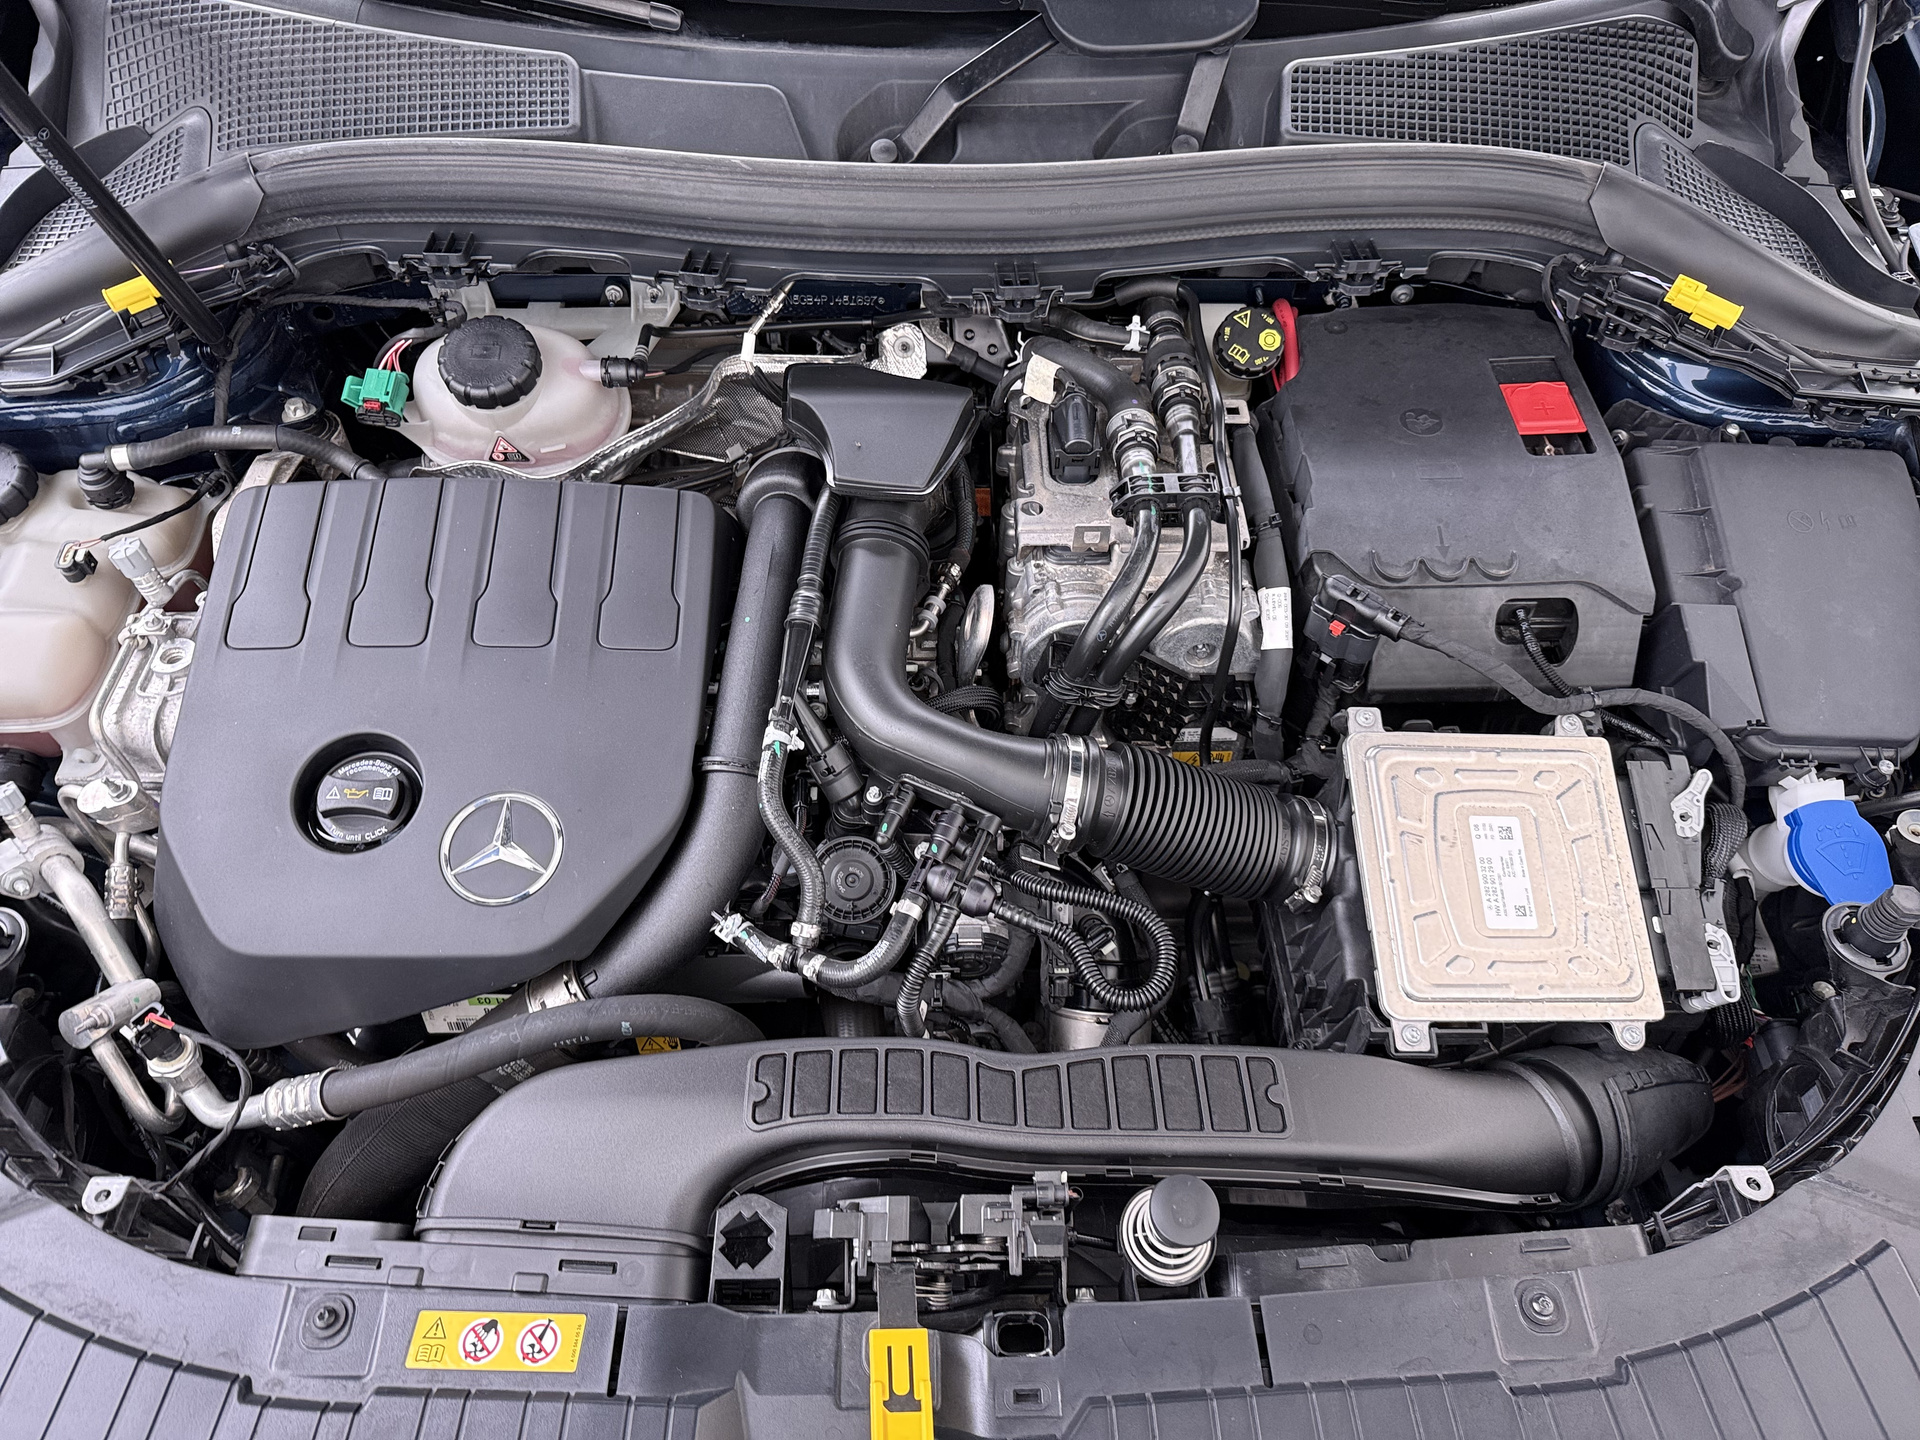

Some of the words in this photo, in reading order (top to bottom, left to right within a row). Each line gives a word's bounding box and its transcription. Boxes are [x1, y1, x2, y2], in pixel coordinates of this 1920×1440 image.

[756, 295, 876, 306] WN8GB4PJ481697
[338, 759, 392, 775] Mercedes-Benz
[391, 766, 401, 777] Oil
[346, 765, 393, 777] recommended
[330, 825, 344, 838] Turn
[365, 826, 388, 841] CLICK
[1479, 856, 1485, 864] 00
[1486, 857, 1492, 865] 00
[1481, 865, 1486, 873] 32
[1494, 904, 1501, 917] HW
